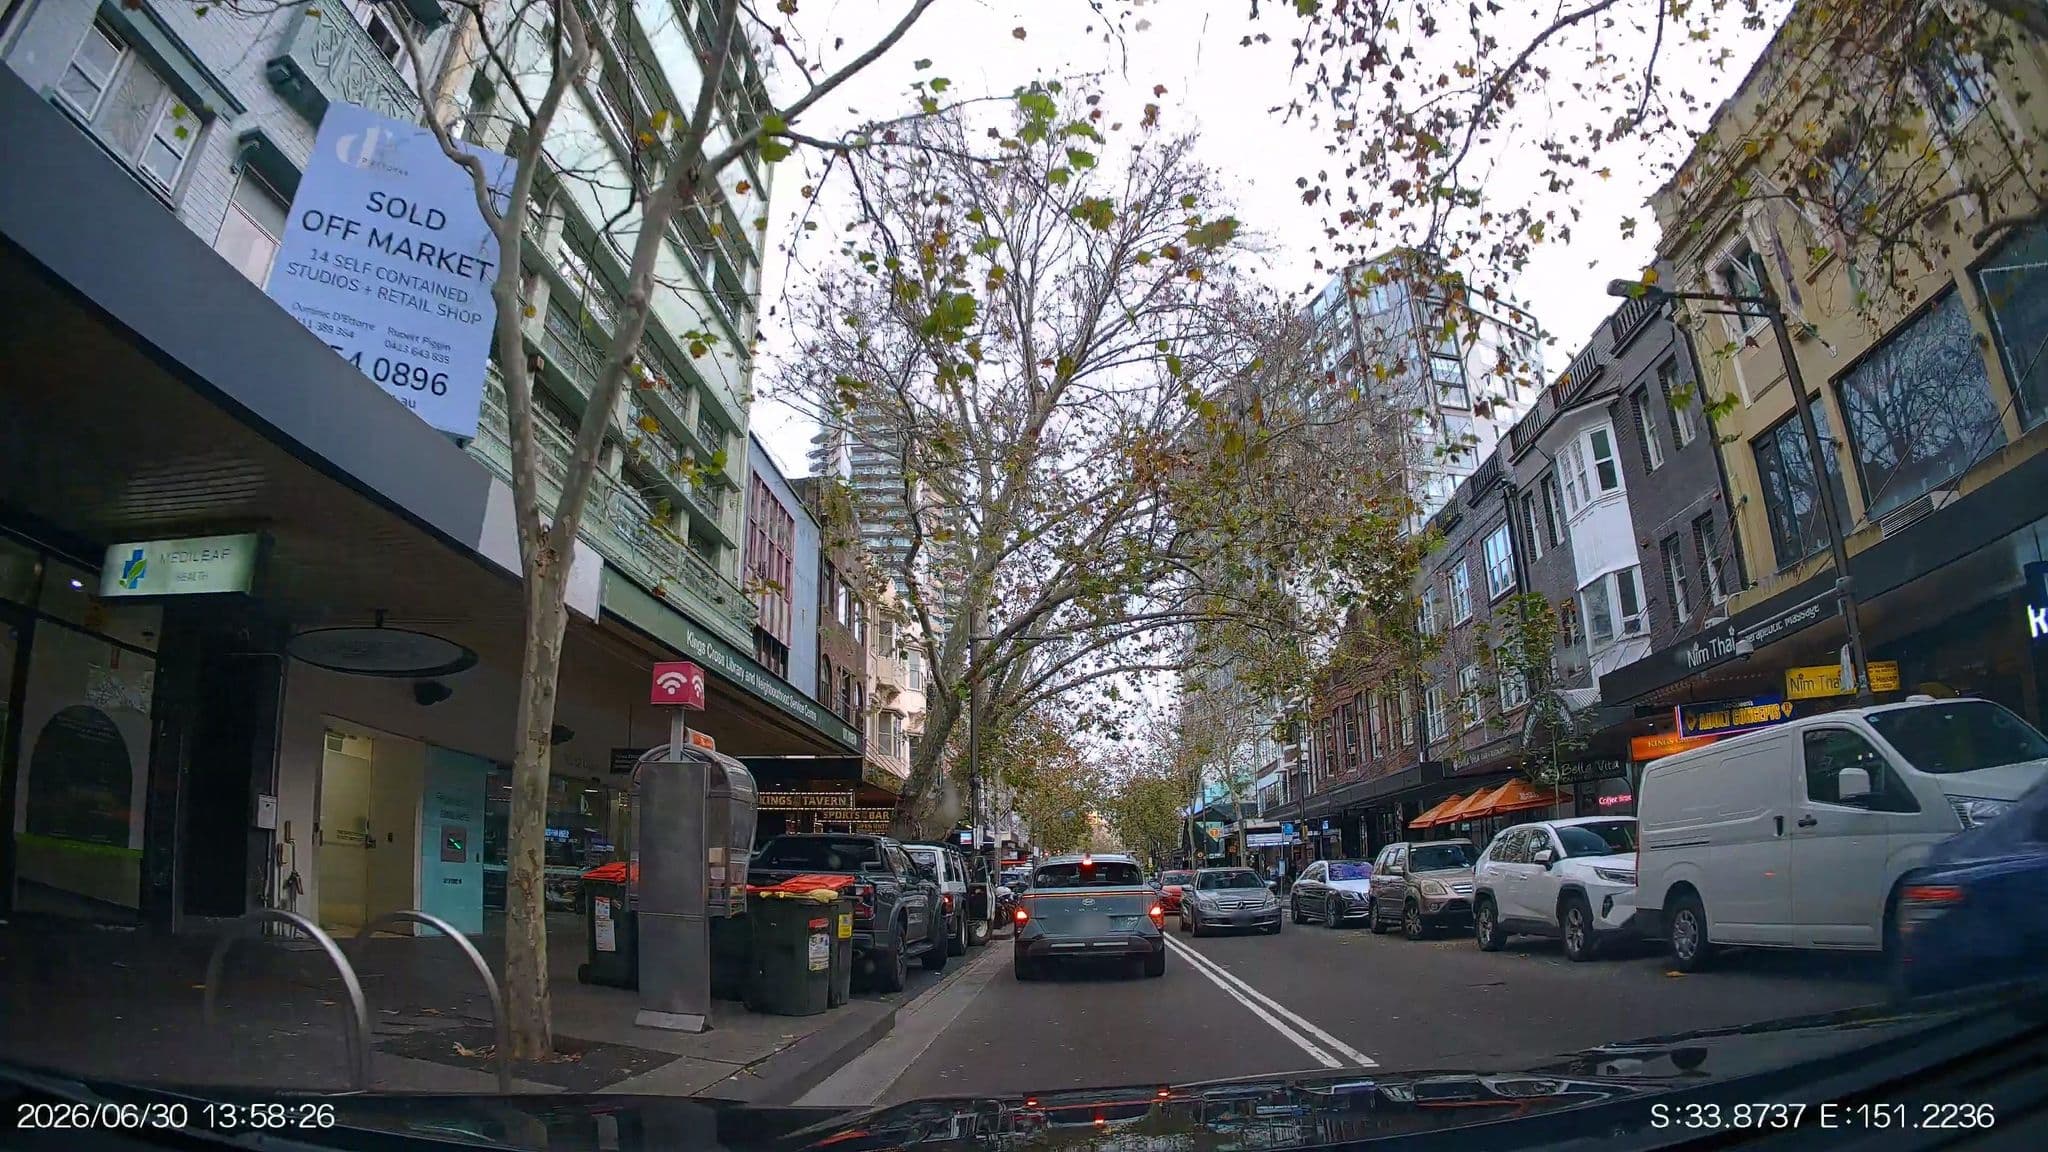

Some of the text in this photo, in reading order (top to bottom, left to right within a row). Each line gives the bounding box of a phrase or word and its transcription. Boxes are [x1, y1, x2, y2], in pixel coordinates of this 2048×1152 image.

[366, 191, 446, 231] SOLD
[302, 209, 494, 282] OFF MARKET
[311, 248, 468, 303] 14 SELF CONTAINED
[287, 262, 482, 325] STUDIOS + RETAIL SHOP
[373, 356, 449, 397] 0896
[160, 548, 231, 565] MEDILEAF
[1687, 642, 1710, 669] Nim
[1709, 625, 1736, 659] Thai
[1744, 620, 1784, 643] erapeutic
[686, 631, 706, 656] Kings
[706, 643, 725, 666] Cross
[725, 655, 745, 682] Library
[745, 669, 756, 686] and
[756, 673, 790, 706] Neighbourhood
[789, 694, 805, 716] Service
[1790, 673, 1815, 692] Nim
[1699, 704, 1781, 730] ADULT CONCEPTS
[1648, 738, 1674, 748] KINGS
[1595, 758, 1620, 771] Vita
[759, 796, 847, 806] KINGS TAVERN
[823, 810, 890, 820] SPORTS BAR
